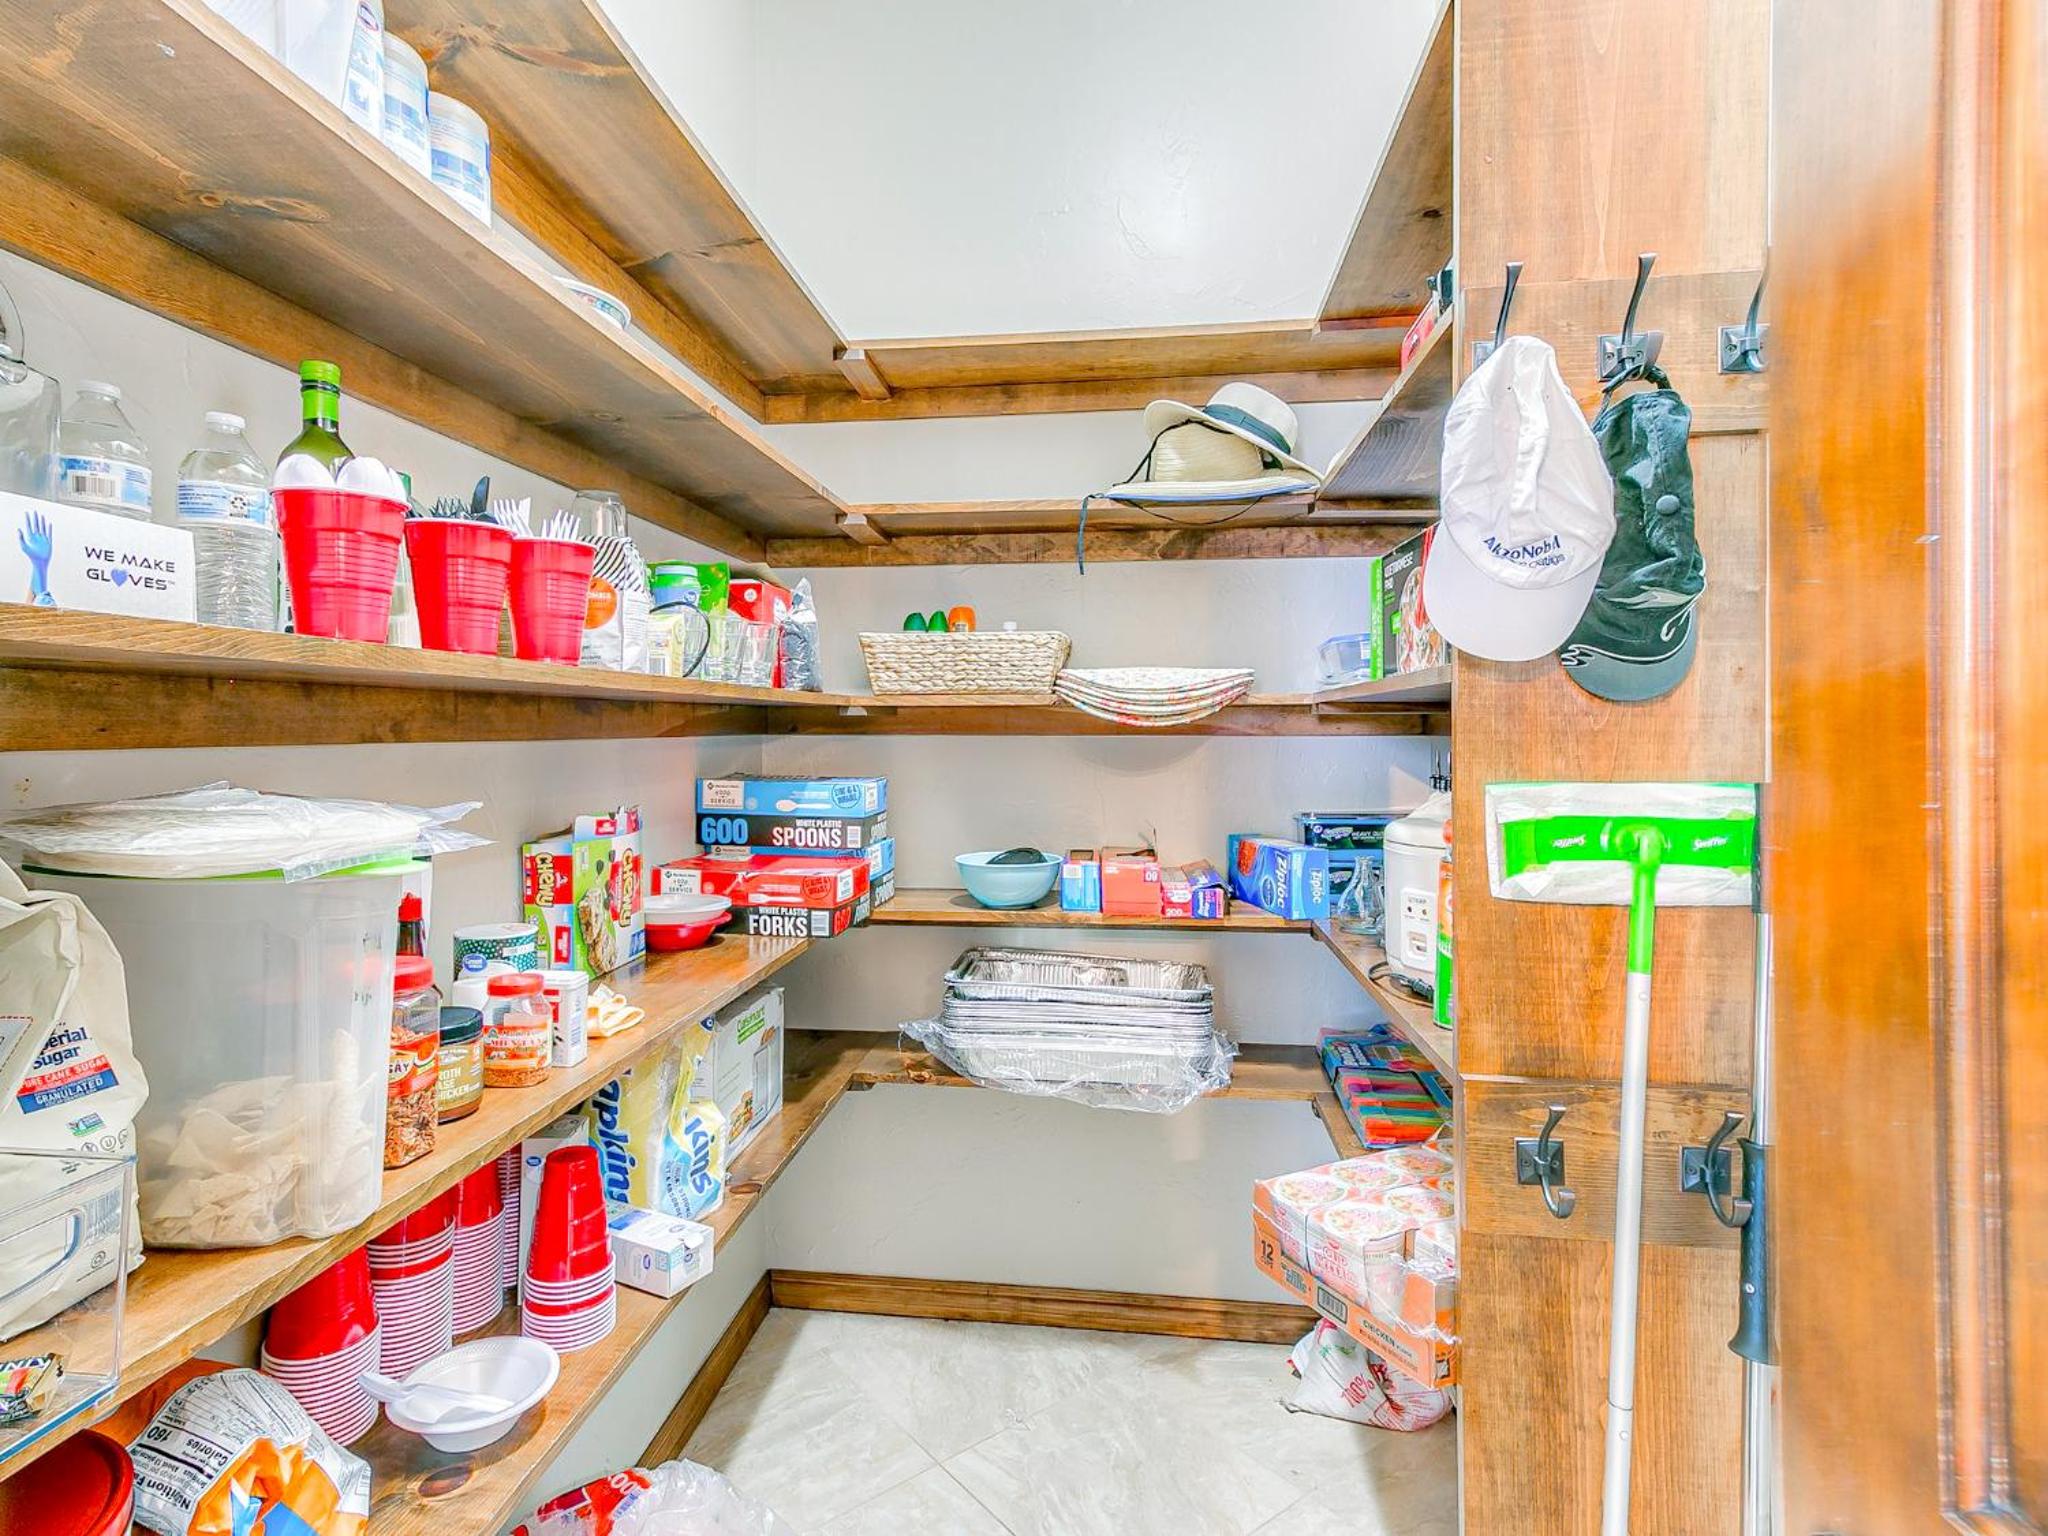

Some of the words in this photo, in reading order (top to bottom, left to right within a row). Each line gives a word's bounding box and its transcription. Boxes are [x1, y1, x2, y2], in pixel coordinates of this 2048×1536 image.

[84, 546, 115, 562] WE
[121, 554, 175, 573] MAKE
[701, 817, 748, 844] 600
[772, 826, 842, 848] SPOONS
[820, 820, 842, 828] PLASTIC
[1693, 838, 1728, 850] Swiffer
[1275, 856, 1288, 909] Ziploc
[1311, 870, 1322, 904] Ziploc
[749, 915, 808, 937] FORKS
[35, 1077, 103, 1104] GRANULATED
[1261, 1240, 1274, 1262] 12
[1363, 1320, 1395, 1347] CHICKEN
[147, 1426, 173, 1442] 160
[186, 1439, 228, 1466] Calories
